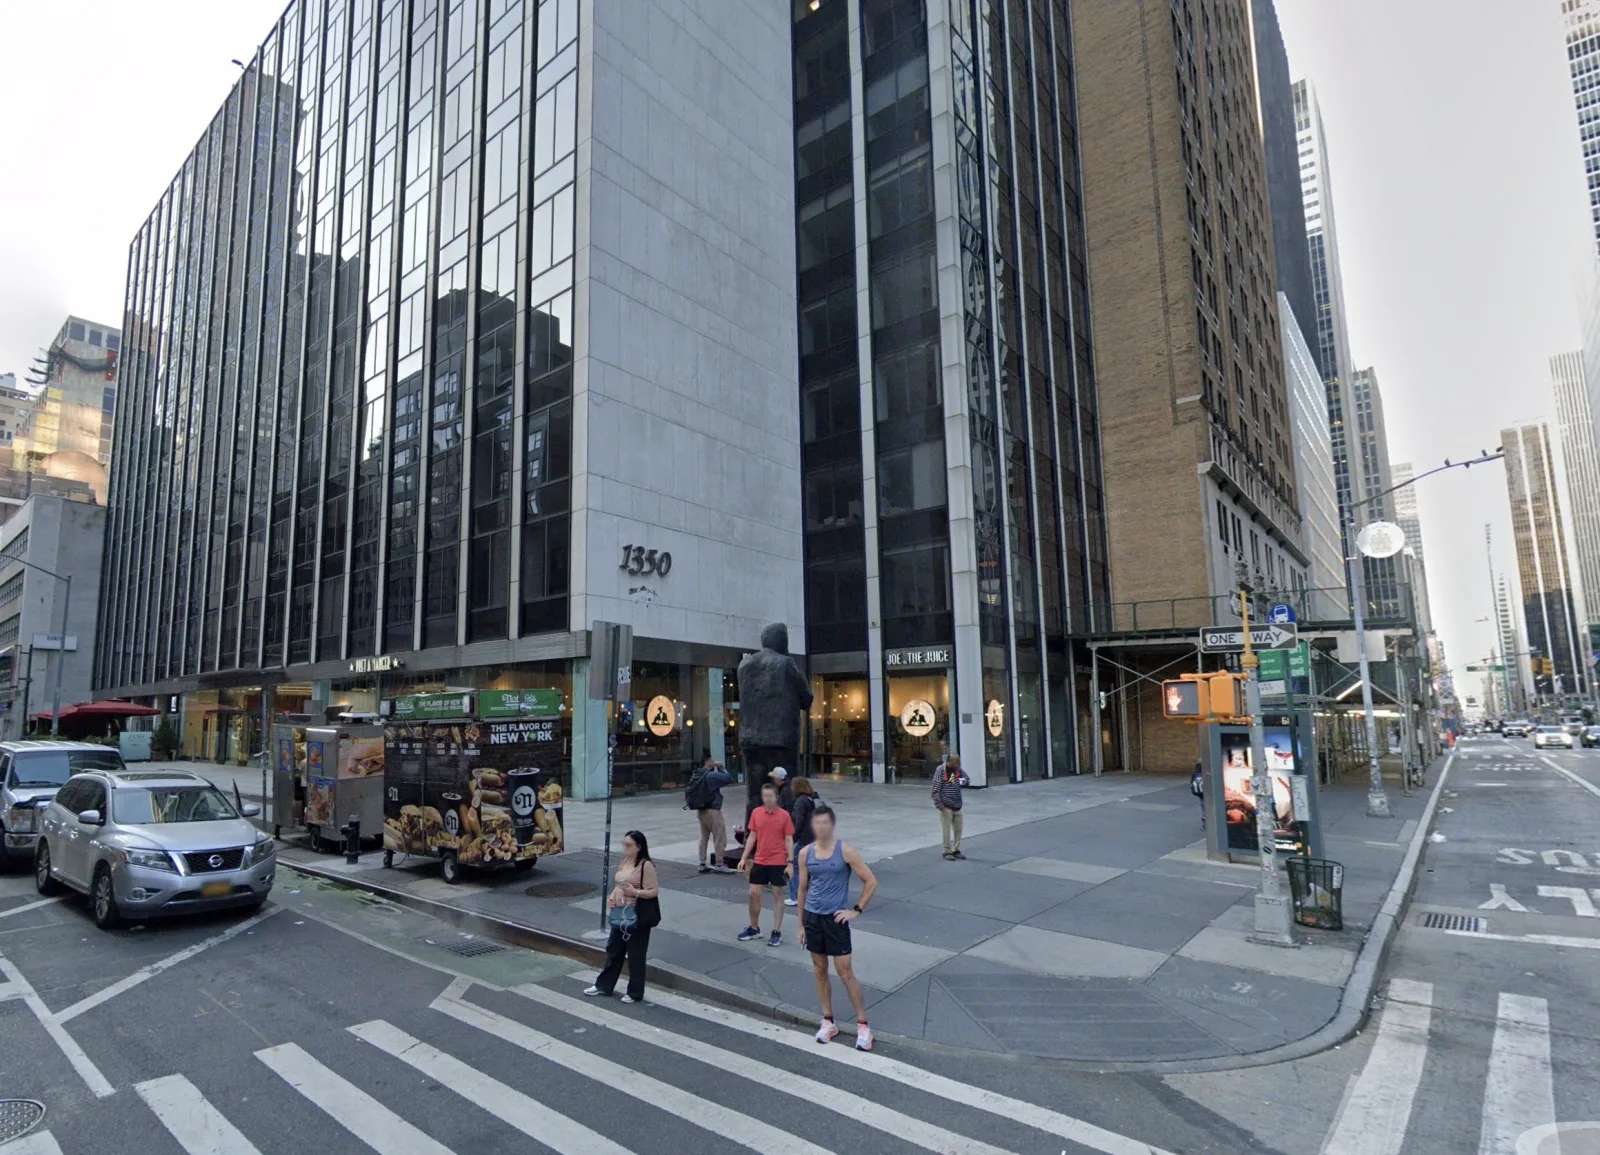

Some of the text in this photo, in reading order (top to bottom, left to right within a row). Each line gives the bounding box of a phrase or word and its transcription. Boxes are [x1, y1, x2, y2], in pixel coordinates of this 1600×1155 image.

[619, 543, 672, 577] 1350
[1209, 631, 1282, 645] ONE WAY
[887, 653, 902, 665] JOE
[907, 651, 922, 664] THE
[925, 649, 949, 663] JUICE
[491, 722, 553, 733] THE FLAVOR OF
[490, 732, 519, 745] NEW
